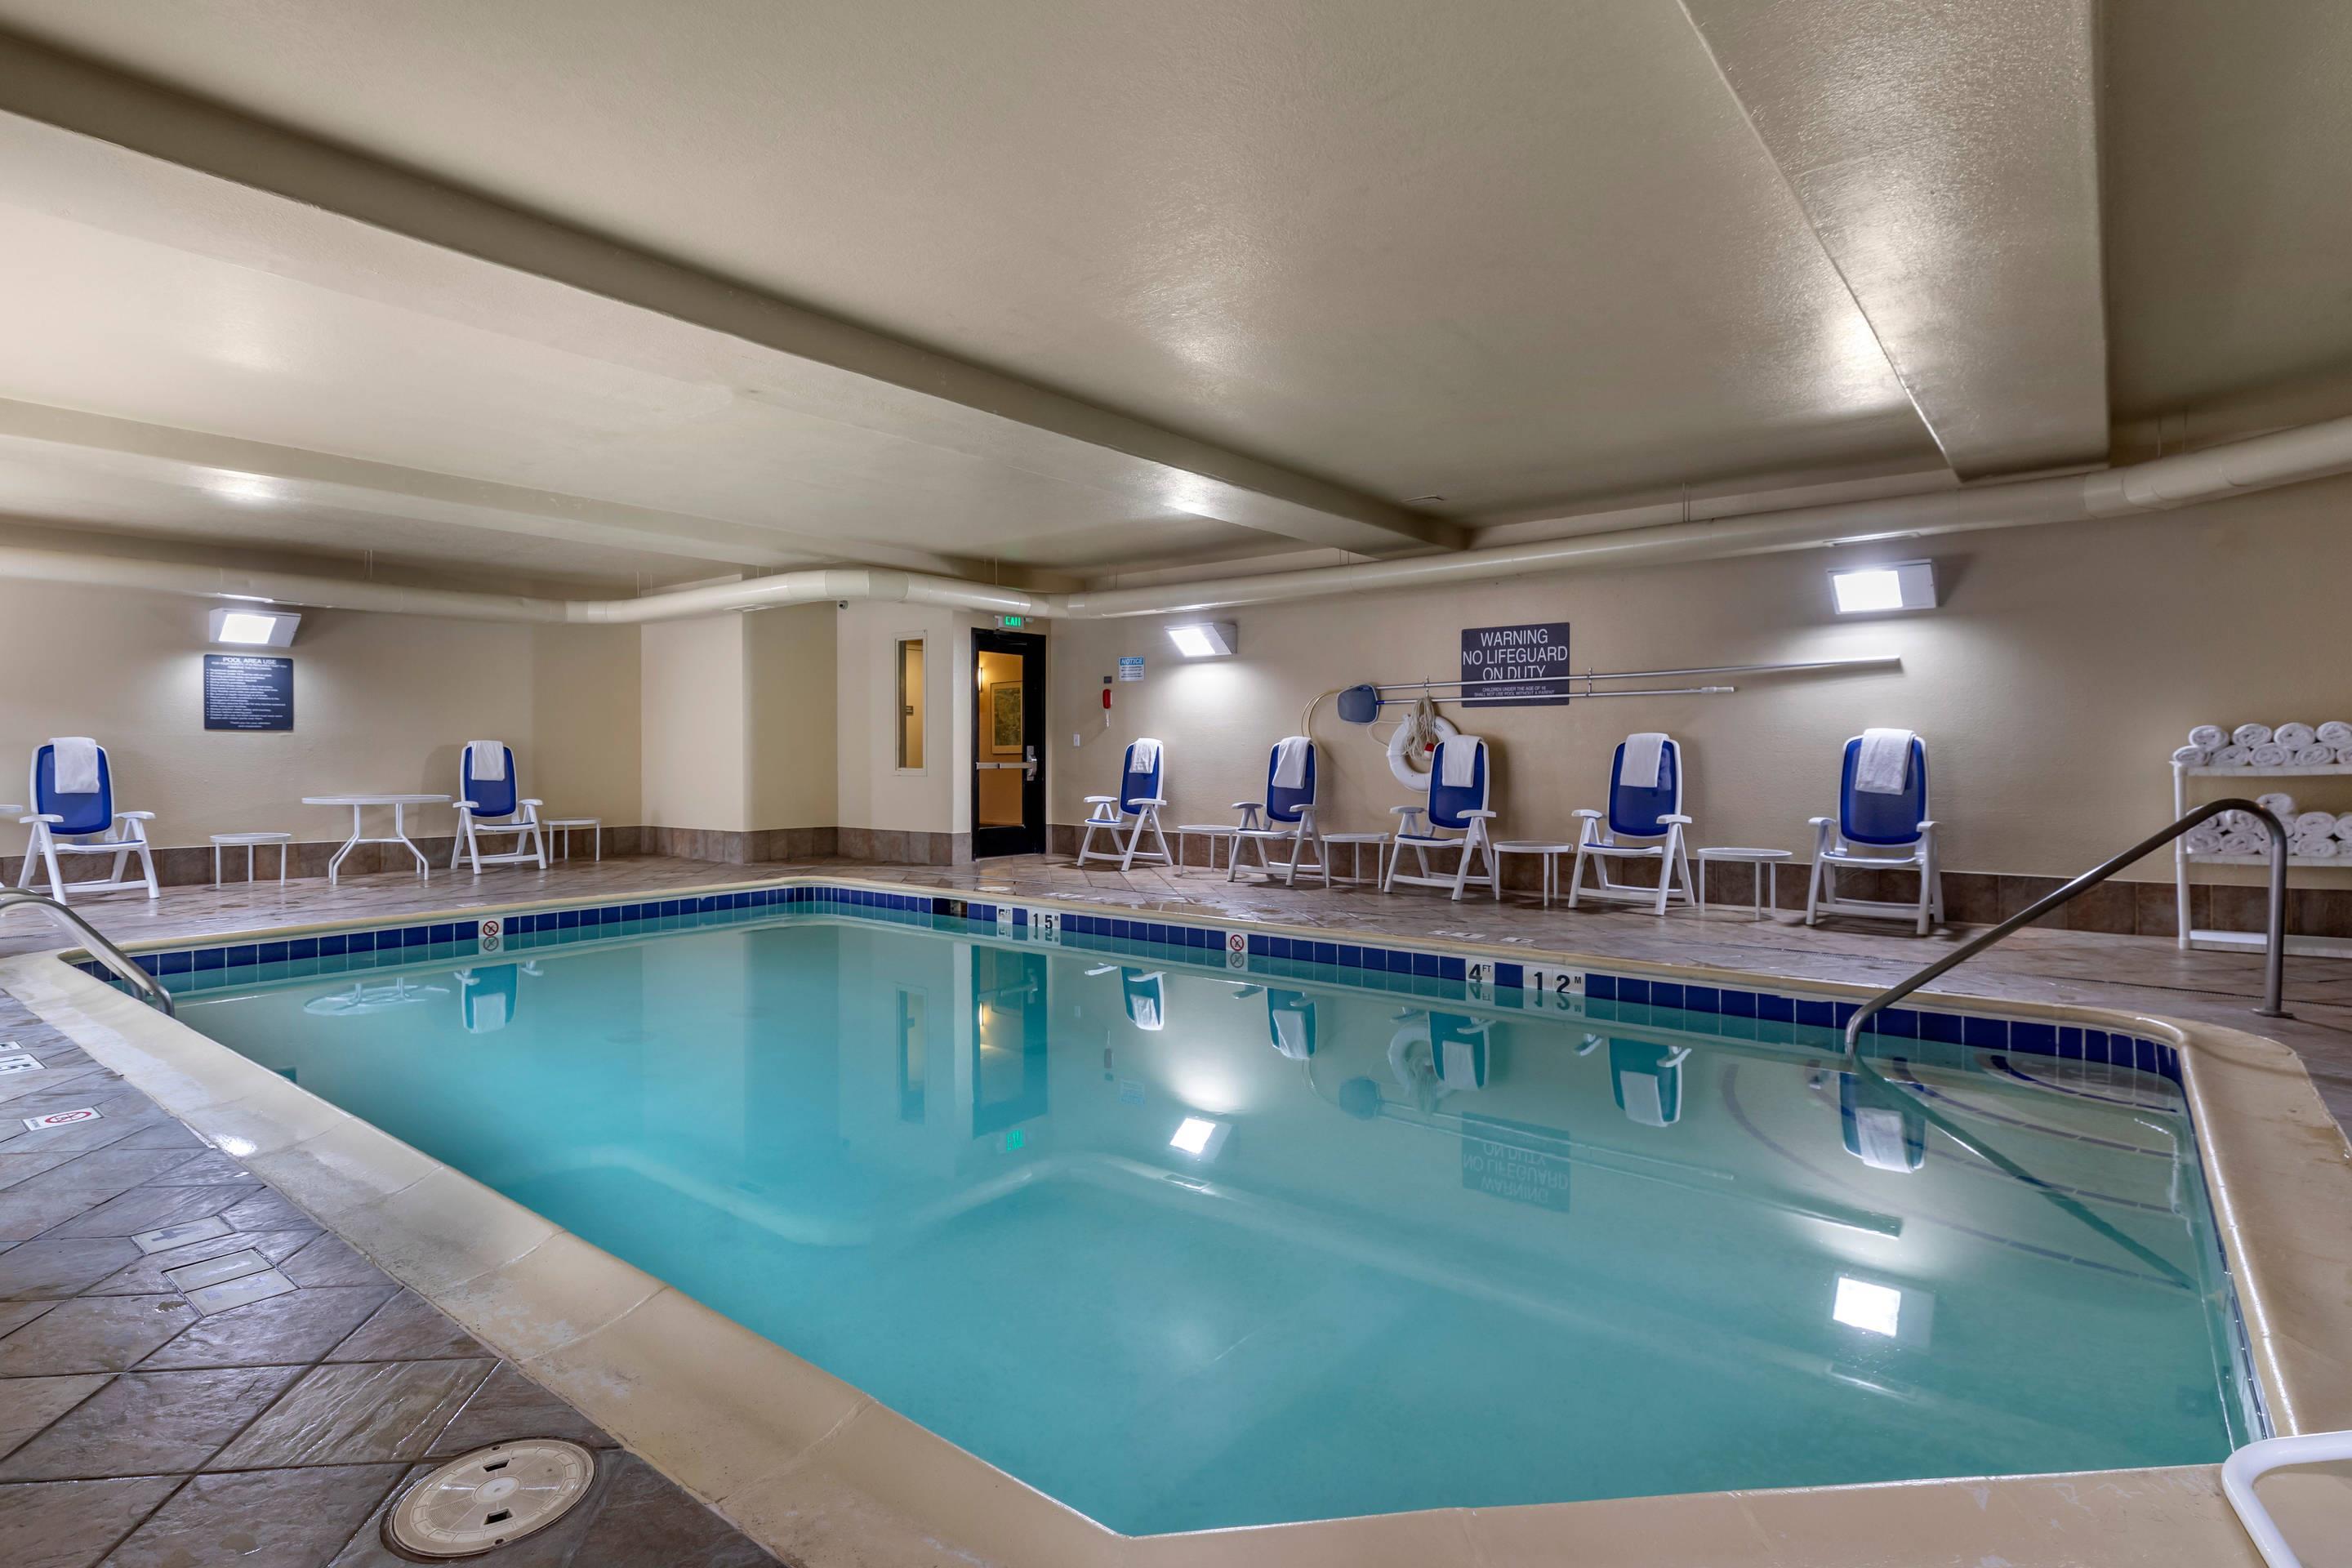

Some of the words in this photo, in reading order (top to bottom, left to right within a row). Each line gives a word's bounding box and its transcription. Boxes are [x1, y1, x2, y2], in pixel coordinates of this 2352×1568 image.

[1481, 629, 1548, 647] WARNING
[1463, 650, 1482, 665] NO
[1487, 646, 1567, 664] LIFEGUARD
[1483, 667, 1503, 679] ON
[1508, 665, 1546, 679] DUTY
[1468, 964, 1482, 982] 4
[1575, 976, 1581, 984] M
